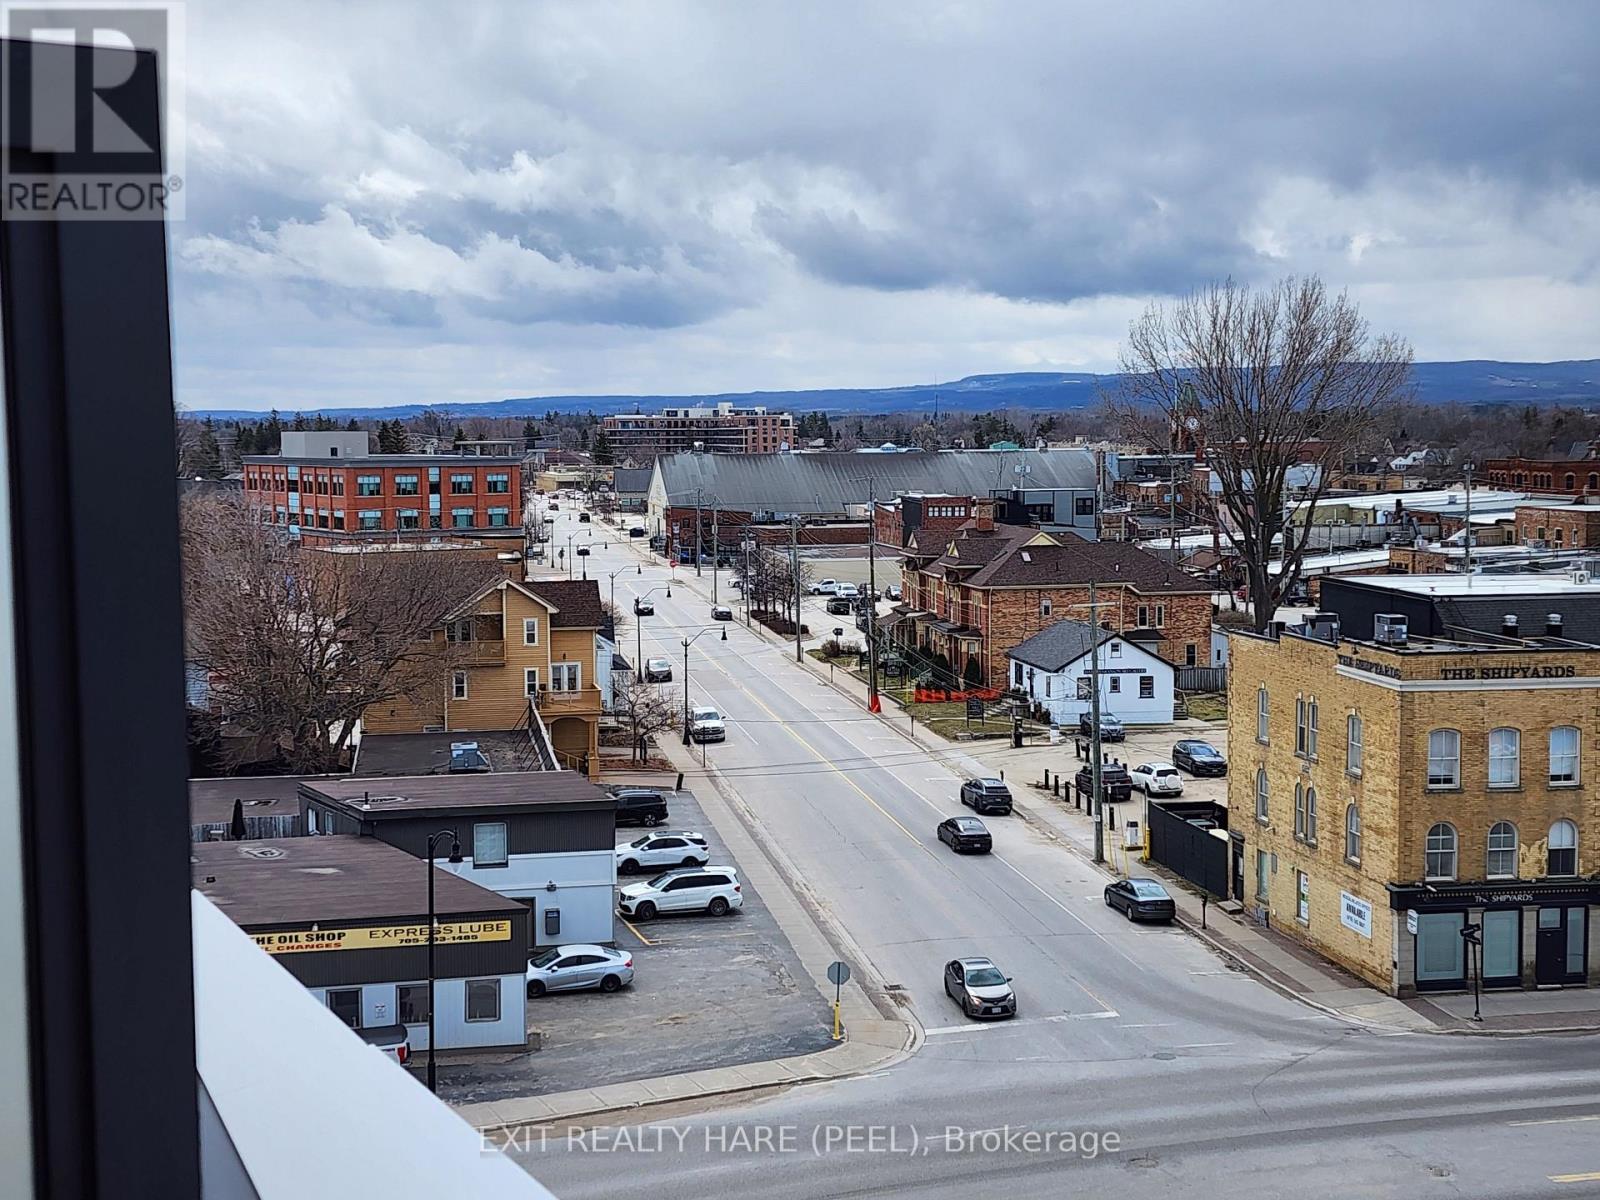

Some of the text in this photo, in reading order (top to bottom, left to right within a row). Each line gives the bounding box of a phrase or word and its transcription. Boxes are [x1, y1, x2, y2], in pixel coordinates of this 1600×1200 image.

[1440, 665, 1576, 680] THE SHIPYARDS
[369, 922, 507, 939] EXPRESS LUBE
[250, 932, 346, 945] HE OIL SHOP
[276, 942, 342, 952] CHANGES
